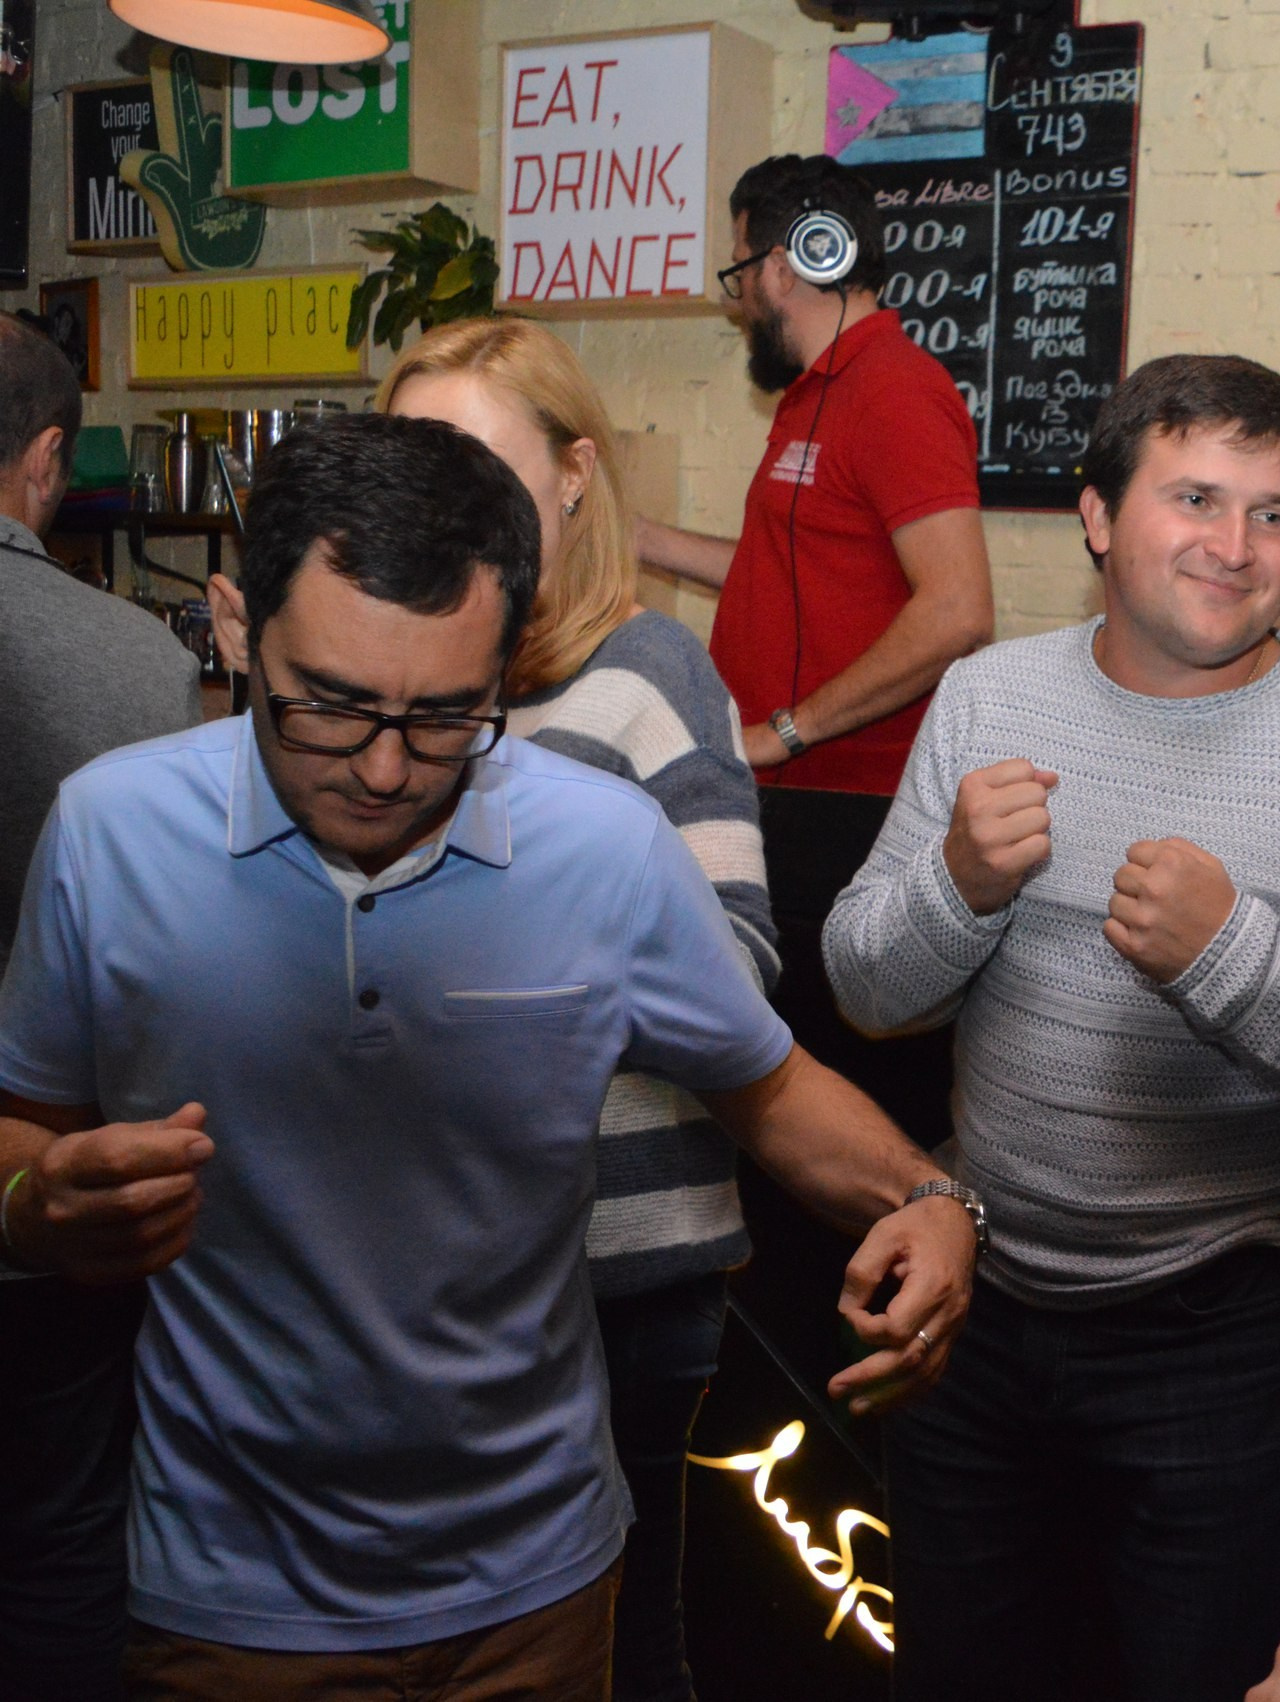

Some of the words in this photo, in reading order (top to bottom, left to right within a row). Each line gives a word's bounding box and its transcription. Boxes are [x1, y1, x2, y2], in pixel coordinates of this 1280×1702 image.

[1051, 32, 1073, 68] 9
[233, 41, 410, 129] LOST
[512, 60, 620, 129] EAT,
[101, 100, 151, 131] Change
[1017, 112, 1086, 157] 743
[508, 143, 686, 215] DRINK,
[1006, 166, 1128, 195] Bonus
[89, 175, 157, 241] Min
[1019, 205, 1116, 247] 101-я
[507, 233, 696, 300] DANCE
[136, 286, 235, 370] Happy
[265, 276, 359, 366] plac
[1033, 287, 1087, 315] рома
